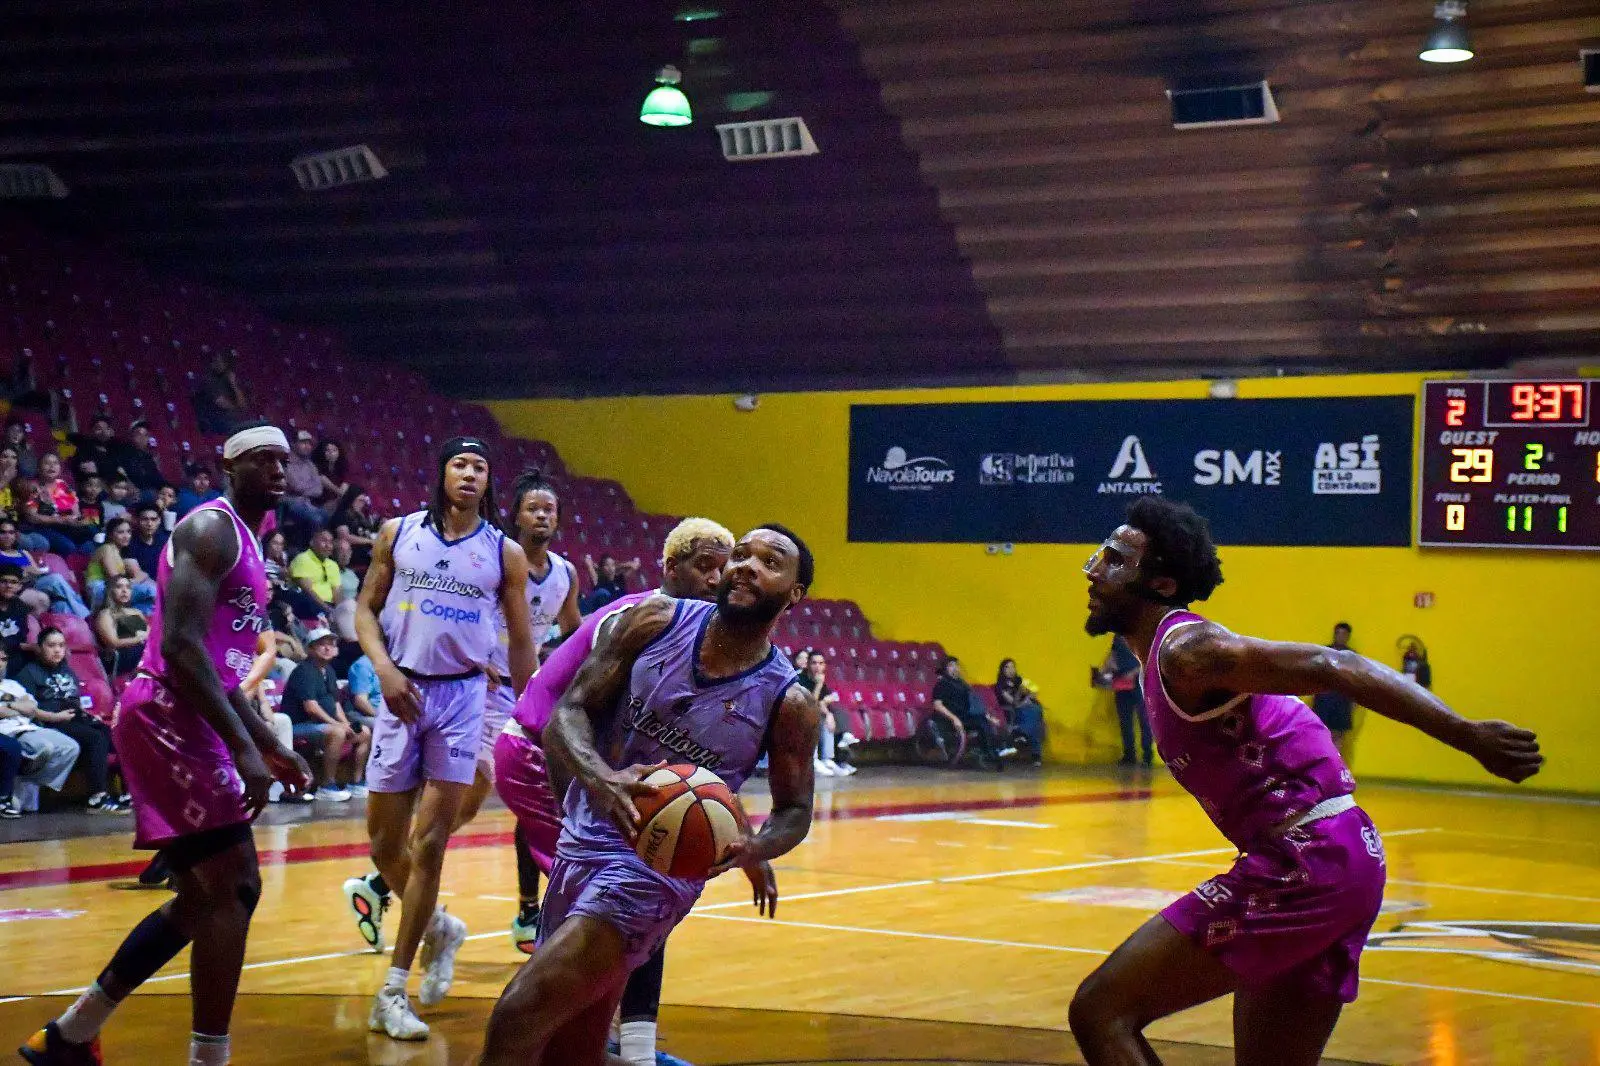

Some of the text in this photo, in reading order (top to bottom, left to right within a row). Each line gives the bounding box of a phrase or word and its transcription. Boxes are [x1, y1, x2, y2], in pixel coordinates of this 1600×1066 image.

[1446, 399, 1466, 426] 2
[1511, 384, 1583, 420] 9:37
[1440, 431, 1499, 445] GUEST
[1574, 431, 1600, 445] HO
[1450, 448, 1493, 482] 29
[1524, 443, 1543, 470] 2
[1507, 473, 1561, 486] PERIOD
[420, 598, 481, 624] Coppel
